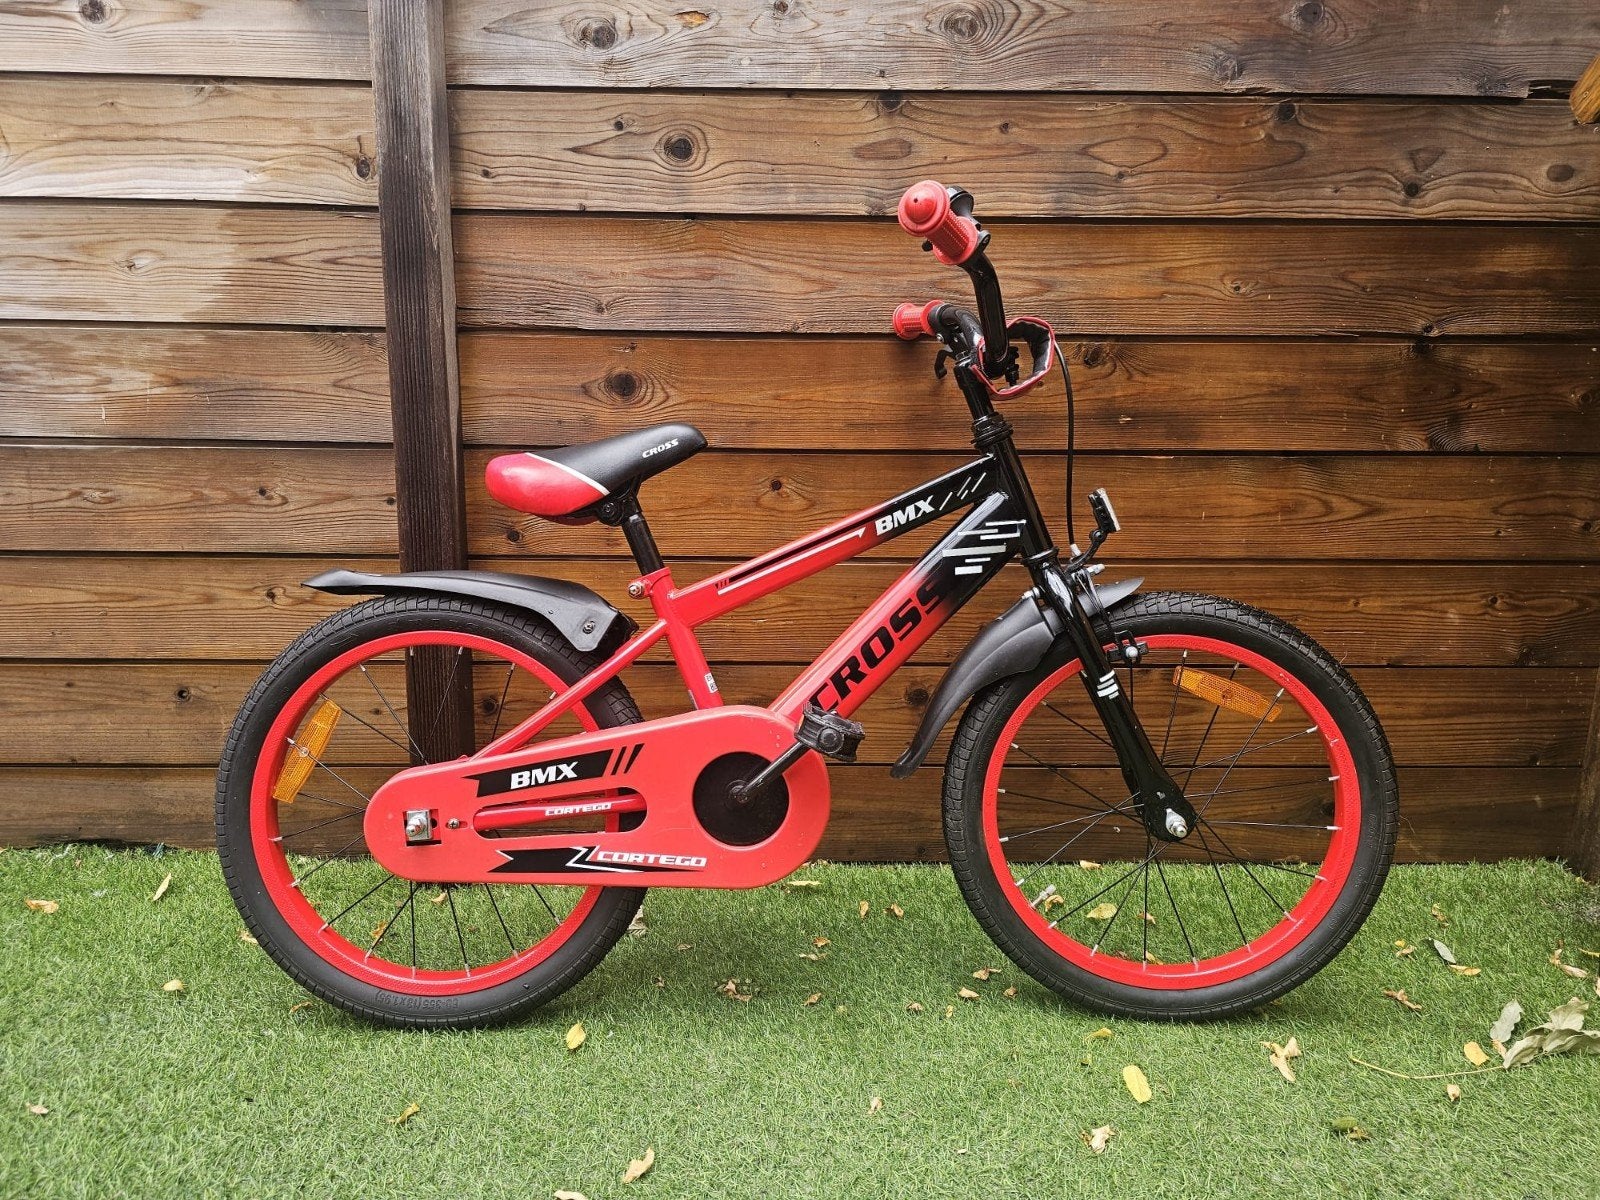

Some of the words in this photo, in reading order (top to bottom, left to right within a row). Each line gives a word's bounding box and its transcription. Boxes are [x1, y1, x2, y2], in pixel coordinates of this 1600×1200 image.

[642, 438, 679, 458] CROSS
[874, 494, 935, 537] BMX
[808, 573, 948, 711] CROSS
[510, 761, 578, 790] BMX
[545, 802, 614, 817] CORTEGO
[597, 850, 708, 867] CORTEGO
